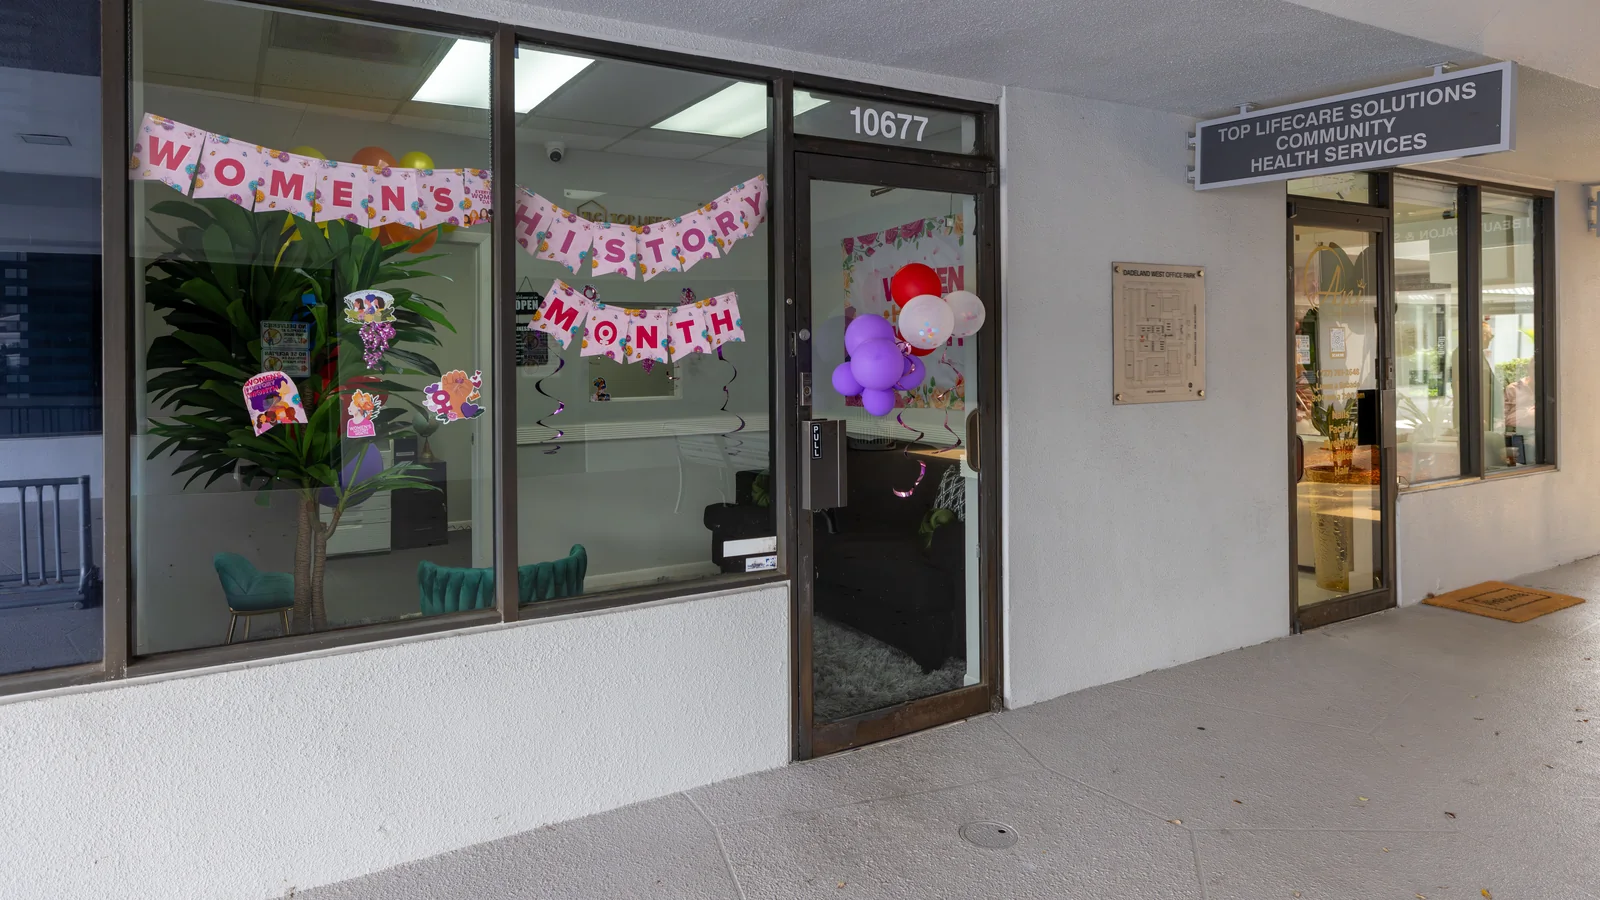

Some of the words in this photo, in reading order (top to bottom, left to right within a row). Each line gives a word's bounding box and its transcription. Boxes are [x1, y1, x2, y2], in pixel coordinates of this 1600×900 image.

[849, 106, 928, 142] 10677
[1218, 123, 1251, 143] TOP
[1255, 106, 1344, 136] LIFECARE
[1349, 81, 1477, 117] SOLUTIONS
[1250, 149, 1319, 173] HEALTH
[1324, 133, 1428, 163] SERVICES
[1276, 117, 1396, 151] COMMUNITY
[148, 136, 455, 213] WOMEN'S
[515, 192, 761, 263] HISTORY
[1123, 269, 1150, 277] DADELAND
[1151, 270, 1165, 278] WEST
[1165, 271, 1183, 279] OFFICE
[515, 300, 539, 310] OPEN
[543, 297, 735, 349] MONTH
[1334, 466, 1349, 476] Hair
